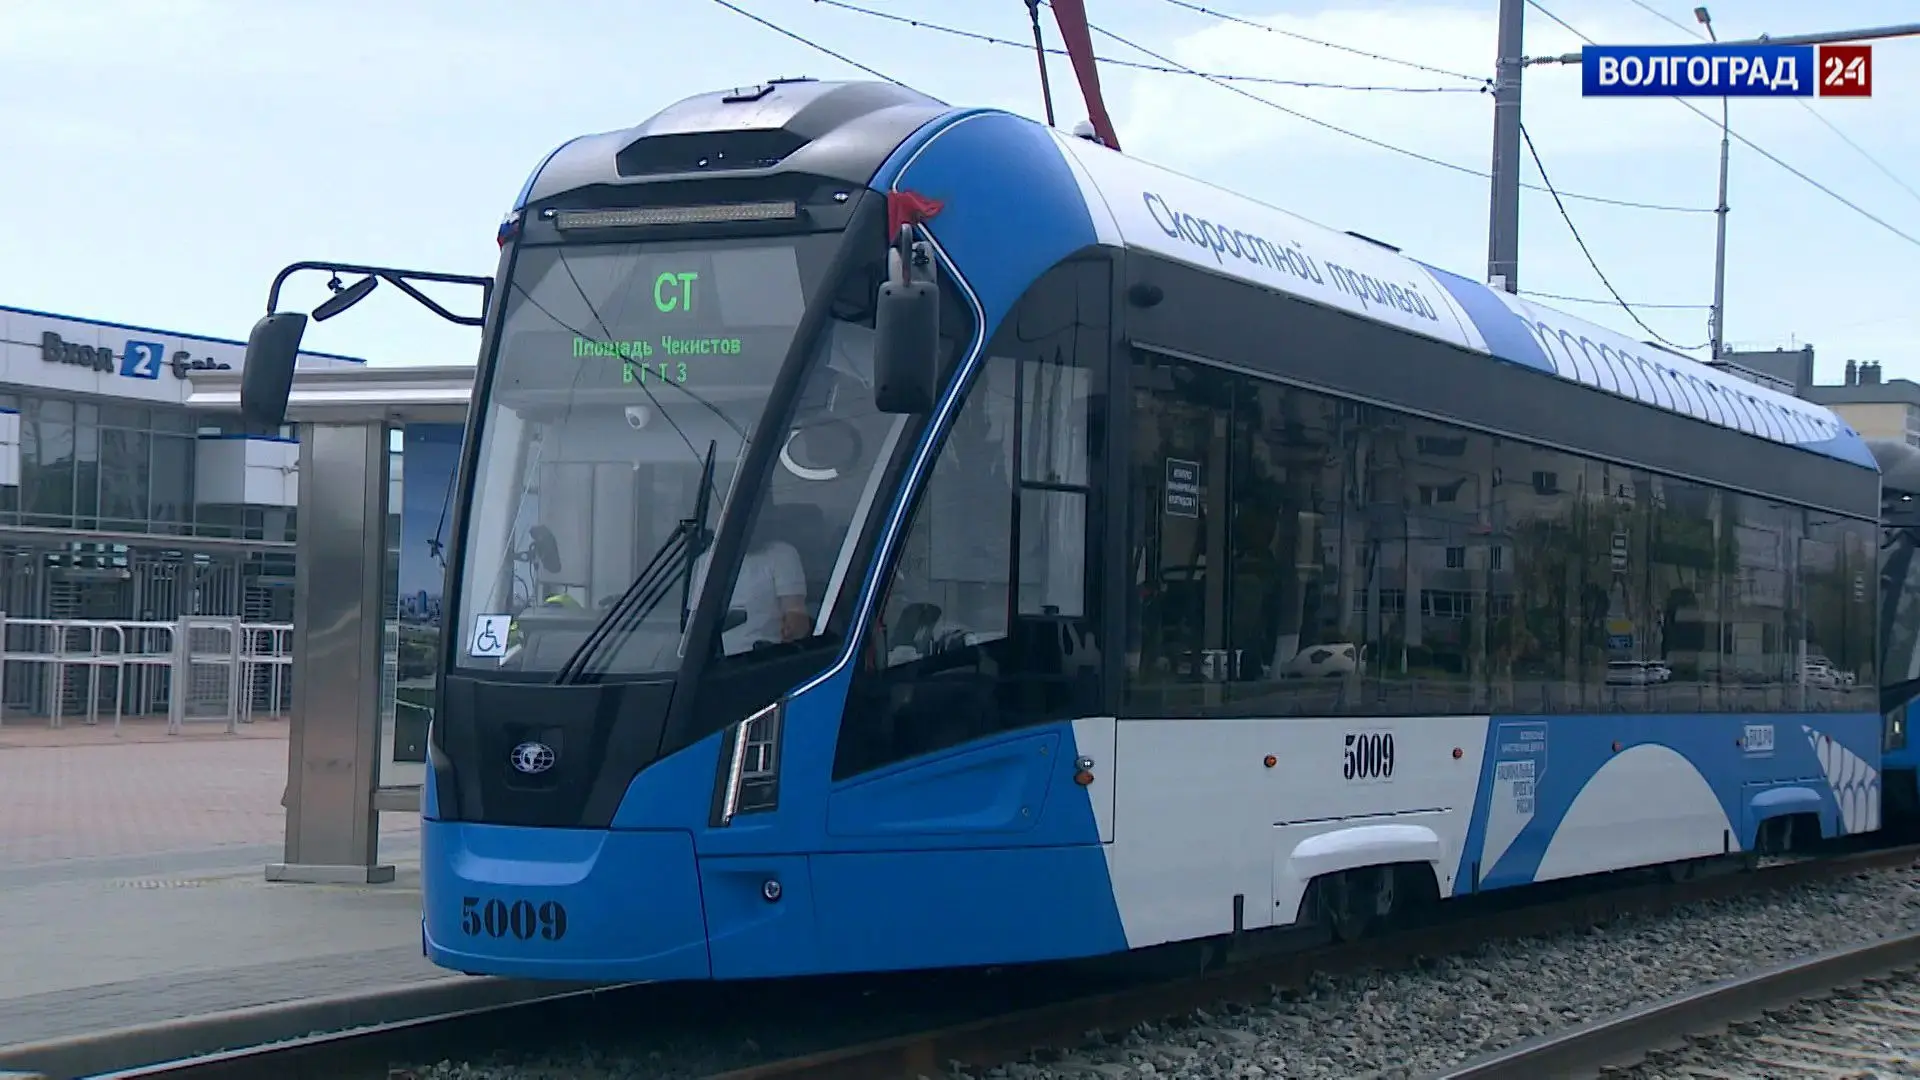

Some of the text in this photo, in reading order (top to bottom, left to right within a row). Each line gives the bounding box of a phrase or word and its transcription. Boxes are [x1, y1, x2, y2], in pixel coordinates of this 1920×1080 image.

[1143, 191, 1440, 322] Скоростной трамвай
[654, 272, 698, 312] СТ
[42, 331, 115, 373] Вход
[133, 345, 152, 376] 2
[573, 335, 742, 359] Площадь Чекистов
[1343, 733, 1395, 780] 5009
[462, 896, 568, 940] 5009
